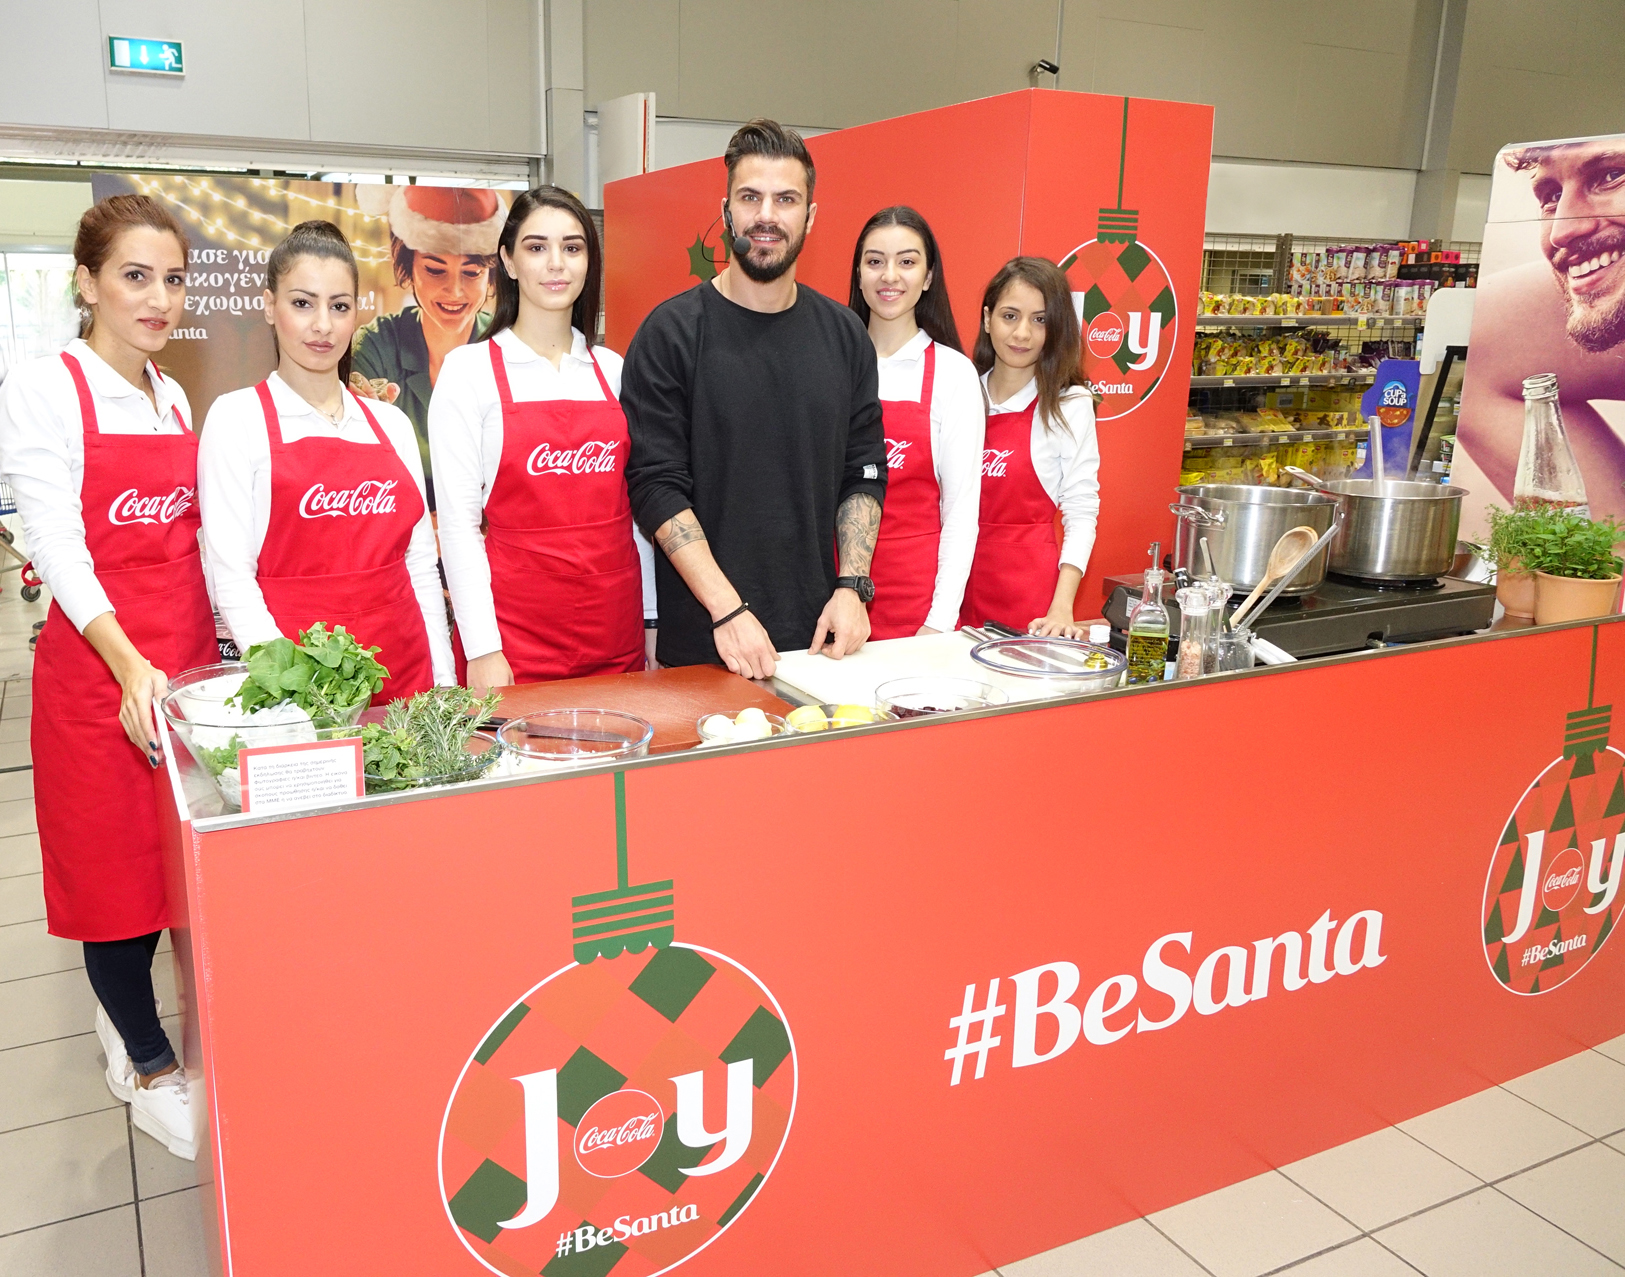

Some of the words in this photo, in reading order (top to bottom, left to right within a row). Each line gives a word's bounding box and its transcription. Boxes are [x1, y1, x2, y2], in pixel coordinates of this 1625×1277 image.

[1088, 328, 1122, 342] Coca-Cola
[1382, 398, 1407, 406] SOUP
[526, 440, 620, 476] Coca-Cola
[299, 480, 398, 518] Coca-Cola
[1544, 866, 1582, 892] Coca-Cola
[1521, 934, 1586, 966] #BeSanta
[944, 908, 1388, 1086] #BeSanta
[578, 1110, 660, 1154] Coca-Cola
[555, 1203, 700, 1258] #BeSanta
